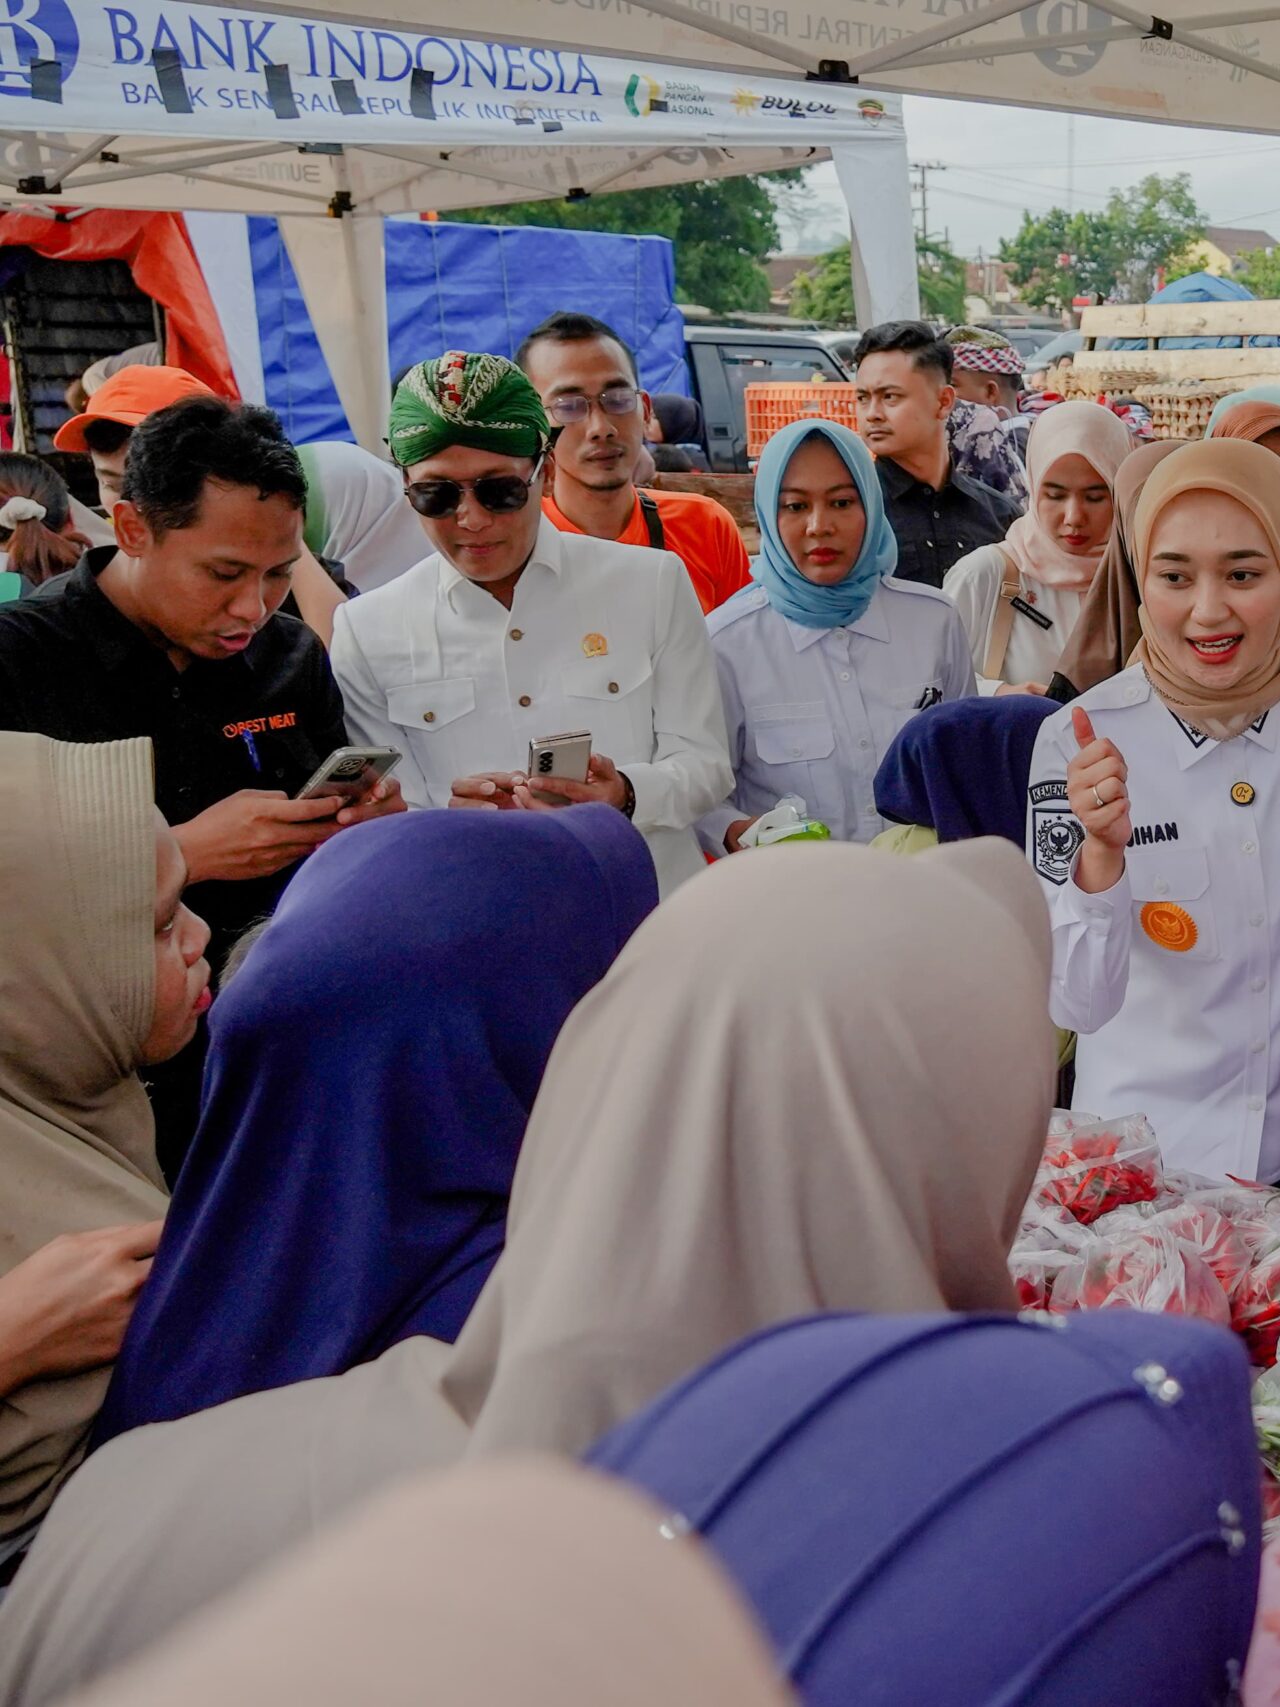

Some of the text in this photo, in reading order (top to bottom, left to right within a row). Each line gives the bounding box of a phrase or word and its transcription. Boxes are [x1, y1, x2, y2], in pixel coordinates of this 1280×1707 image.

[102, 7, 603, 97] BANK INDONESIA
[121, 81, 208, 107] BAK
[217, 88, 342, 112] SENRAL
[670, 104, 715, 117] ASIONAL
[237, 712, 296, 735] BEST MEAT
